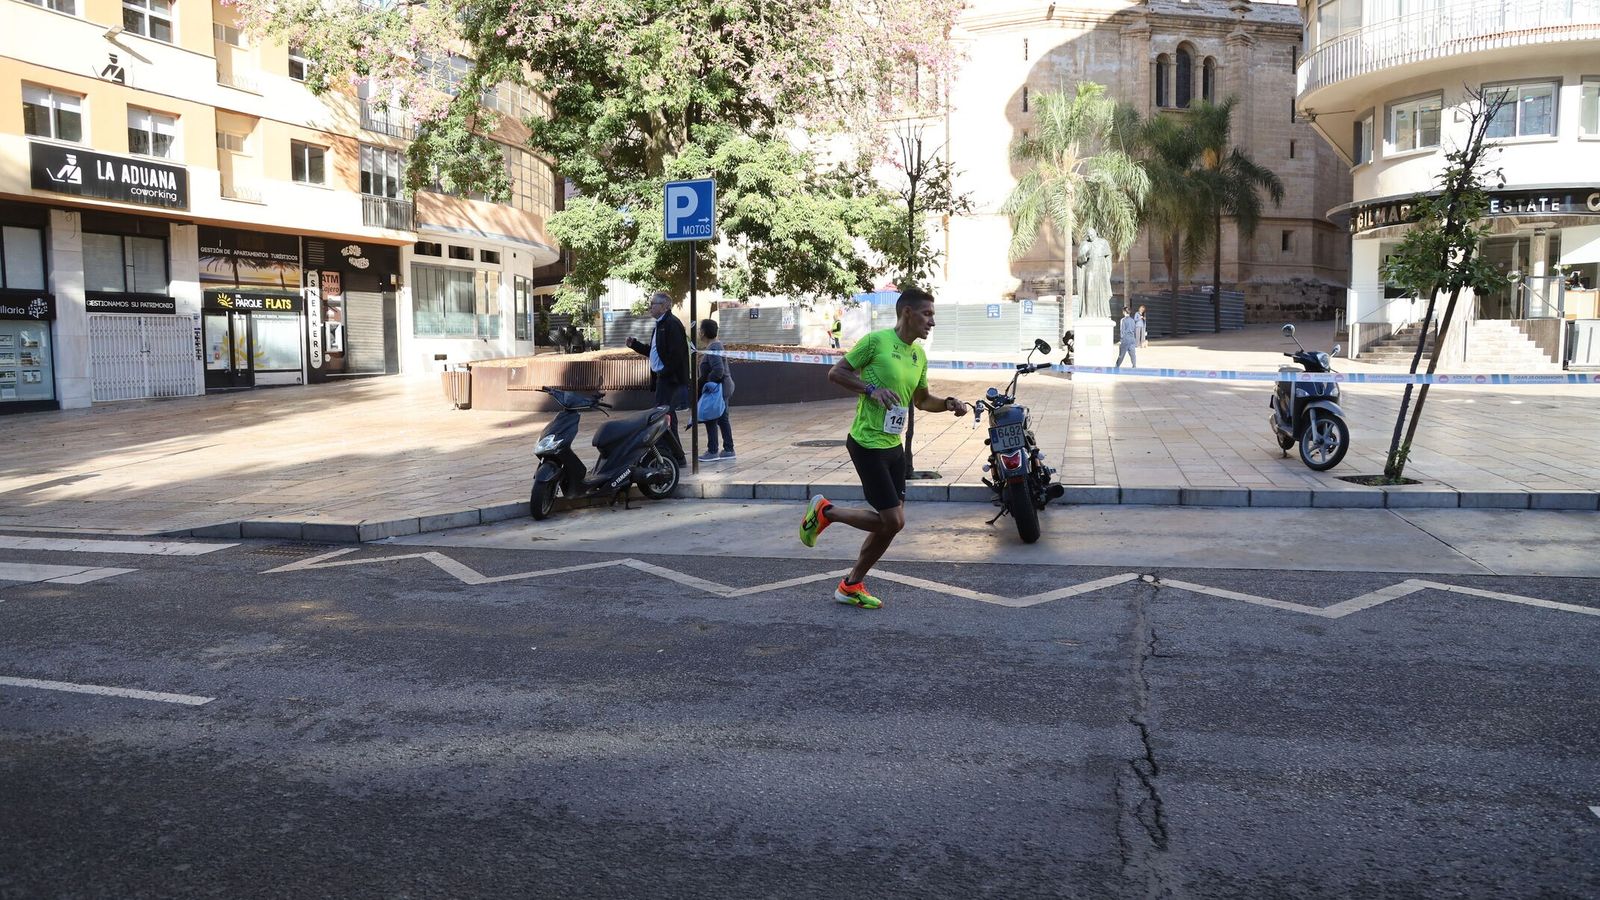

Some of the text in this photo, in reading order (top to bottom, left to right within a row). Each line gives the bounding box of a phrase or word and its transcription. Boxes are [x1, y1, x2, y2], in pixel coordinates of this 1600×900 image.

[97, 160, 177, 191] LA ADUANA
[131, 187, 177, 202] coworking
[668, 186, 699, 235] P
[1490, 198, 1560, 213] ESTATE
[682, 224, 711, 236] MOTOS
[233, 250, 269, 258] APARTAMENTOS
[270, 253, 298, 261] TURÍSTICOS
[86, 300, 129, 308] GESTIONAMOS
[235, 299, 292, 310] PARQUE FLATS
[310, 280, 319, 358] SNEAKERS
[998, 426, 1021, 438] 6492
[1003, 436, 1020, 448] LCD
